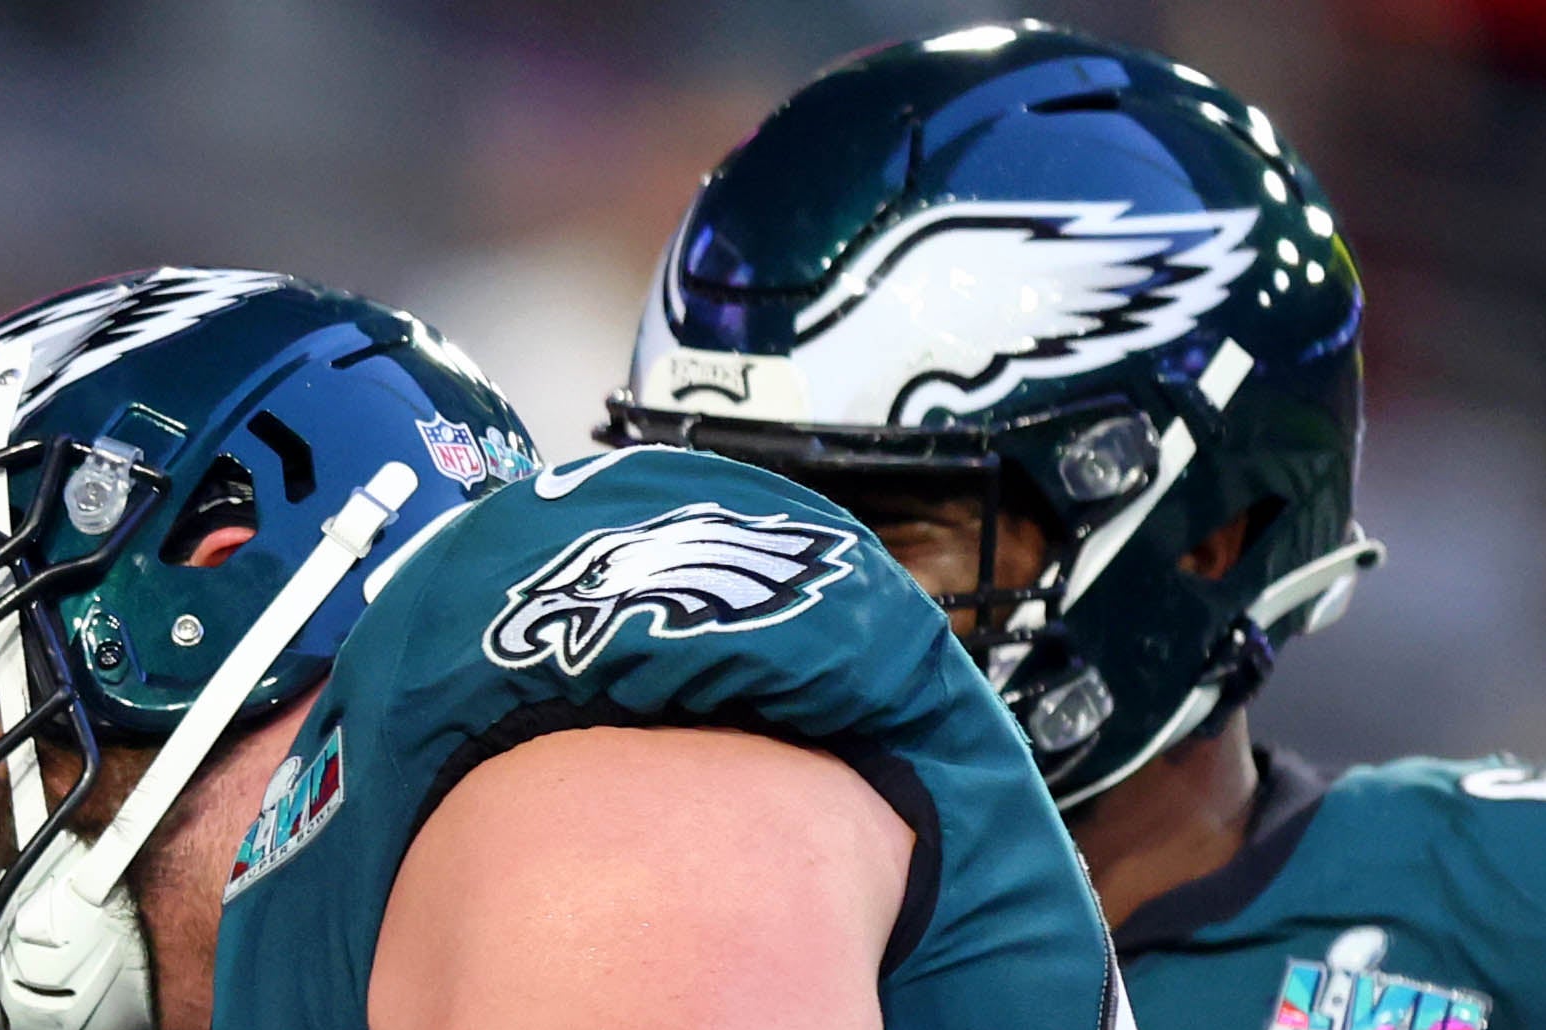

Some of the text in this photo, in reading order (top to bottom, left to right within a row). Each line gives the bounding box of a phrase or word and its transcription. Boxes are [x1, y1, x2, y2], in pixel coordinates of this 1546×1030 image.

[437, 446, 480, 474] NFL
[238, 806, 337, 885] SUPER BOWL
